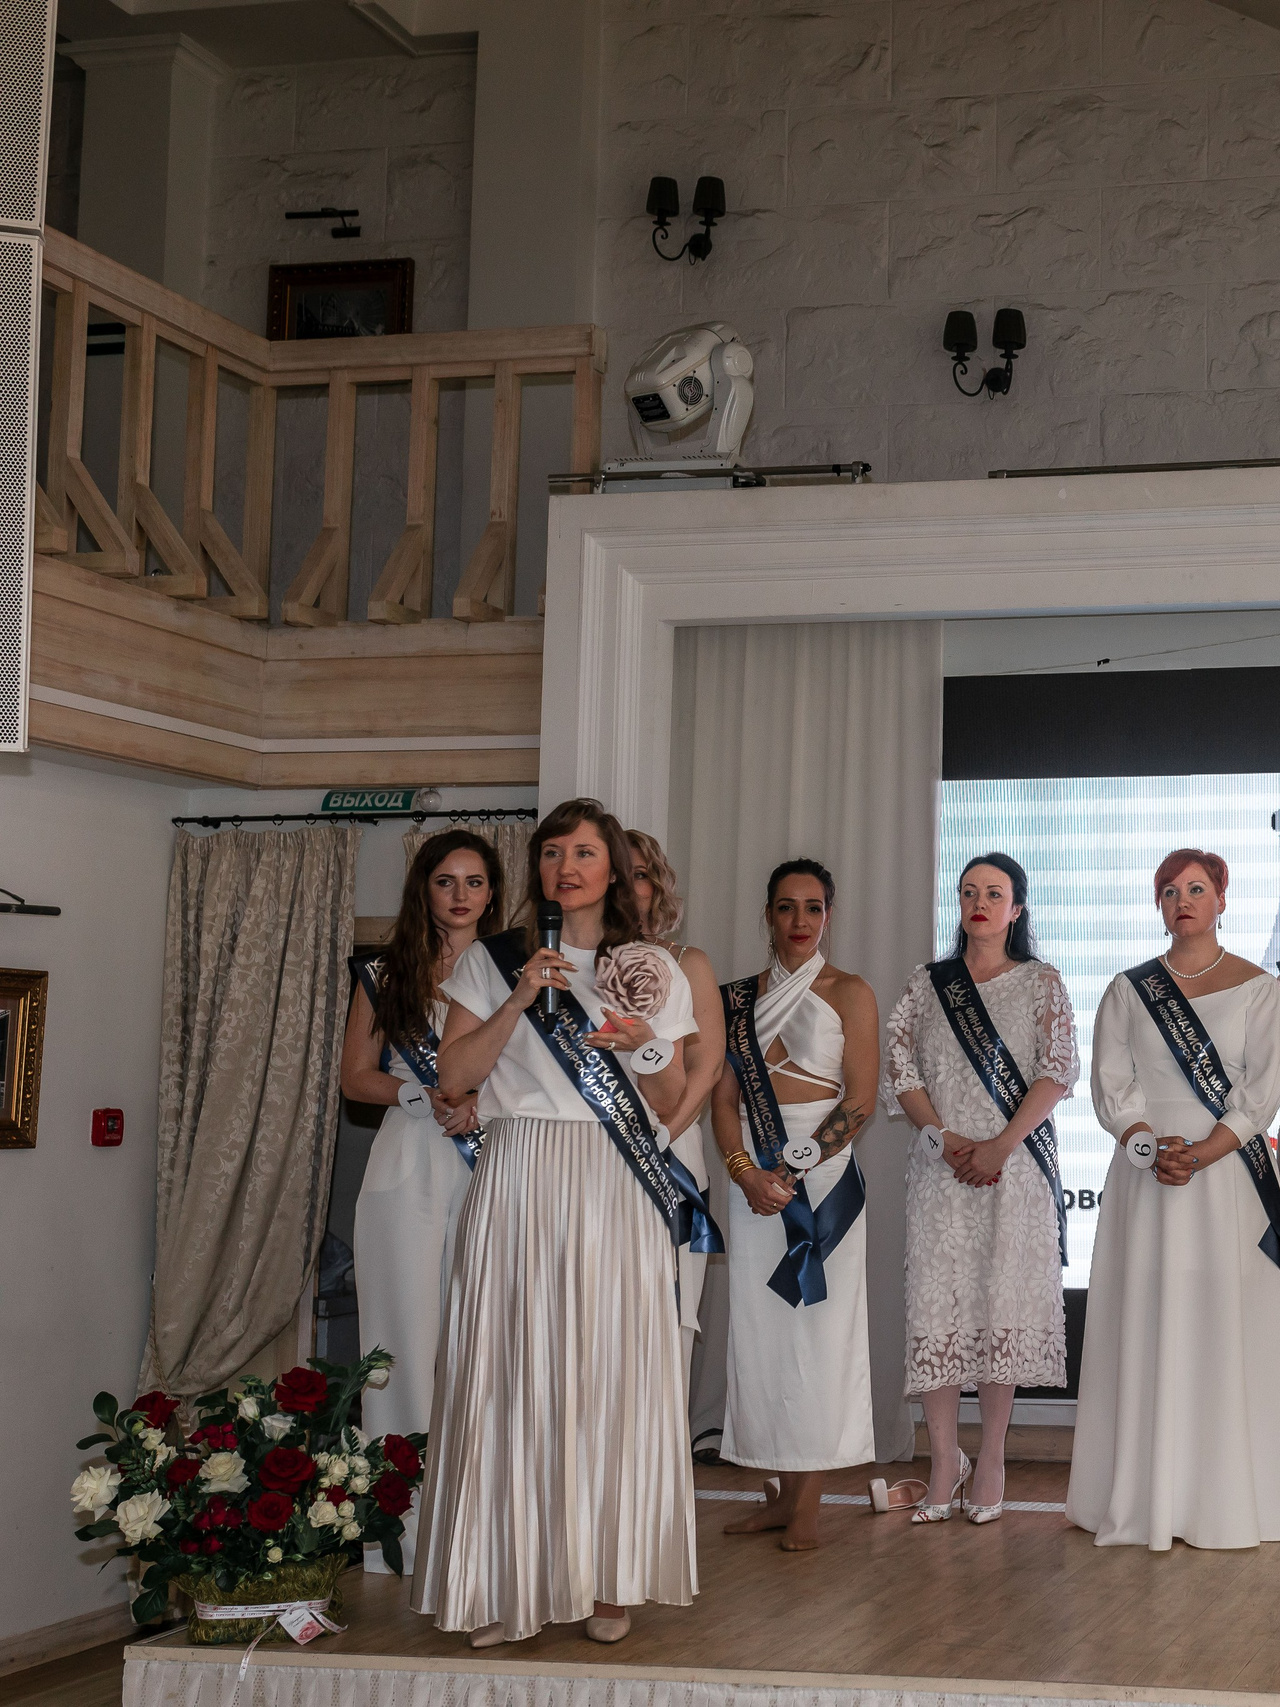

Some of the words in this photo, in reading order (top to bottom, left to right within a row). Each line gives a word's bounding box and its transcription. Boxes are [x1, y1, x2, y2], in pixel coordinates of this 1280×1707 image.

[329, 792, 405, 808] ВЫХОД
[641, 1047, 664, 1066] 5
[965, 1006, 1011, 1081] ФИНАЛИСТКА
[1007, 1078, 1024, 1104] МИС
[1167, 999, 1214, 1077] ФИНАЛИСТКА
[1209, 1074, 1228, 1100] МИС
[407, 1094, 425, 1107] 1
[533, 1003, 590, 1077] НОСИБИРСК
[584, 1074, 594, 1087] И
[590, 1083, 650, 1173] НОВОСИБИРСКАЯ
[647, 1171, 674, 1218] ОБЛАСТЬ
[557, 1006, 619, 1094] ИНАЛИСТКА
[614, 1088, 651, 1152] МИССИС
[648, 1151, 678, 1210] БИЗНЕС
[755, 1091, 780, 1149] МИССИС
[954, 1011, 988, 1070] НОВОСИБИРСК
[986, 1067, 993, 1077] И
[1036, 1141, 1056, 1178] ОБЛАСТЬ
[1156, 1004, 1194, 1065] НОВОСИБИРСК
[1189, 1061, 1198, 1070] И
[1194, 1070, 1227, 1114] НОВОСИБИ
[1244, 1143, 1263, 1180] БЛАСТЬ
[792, 1146, 812, 1160] 3
[927, 1133, 940, 1149] 4
[1133, 1142, 1151, 1157] 6
